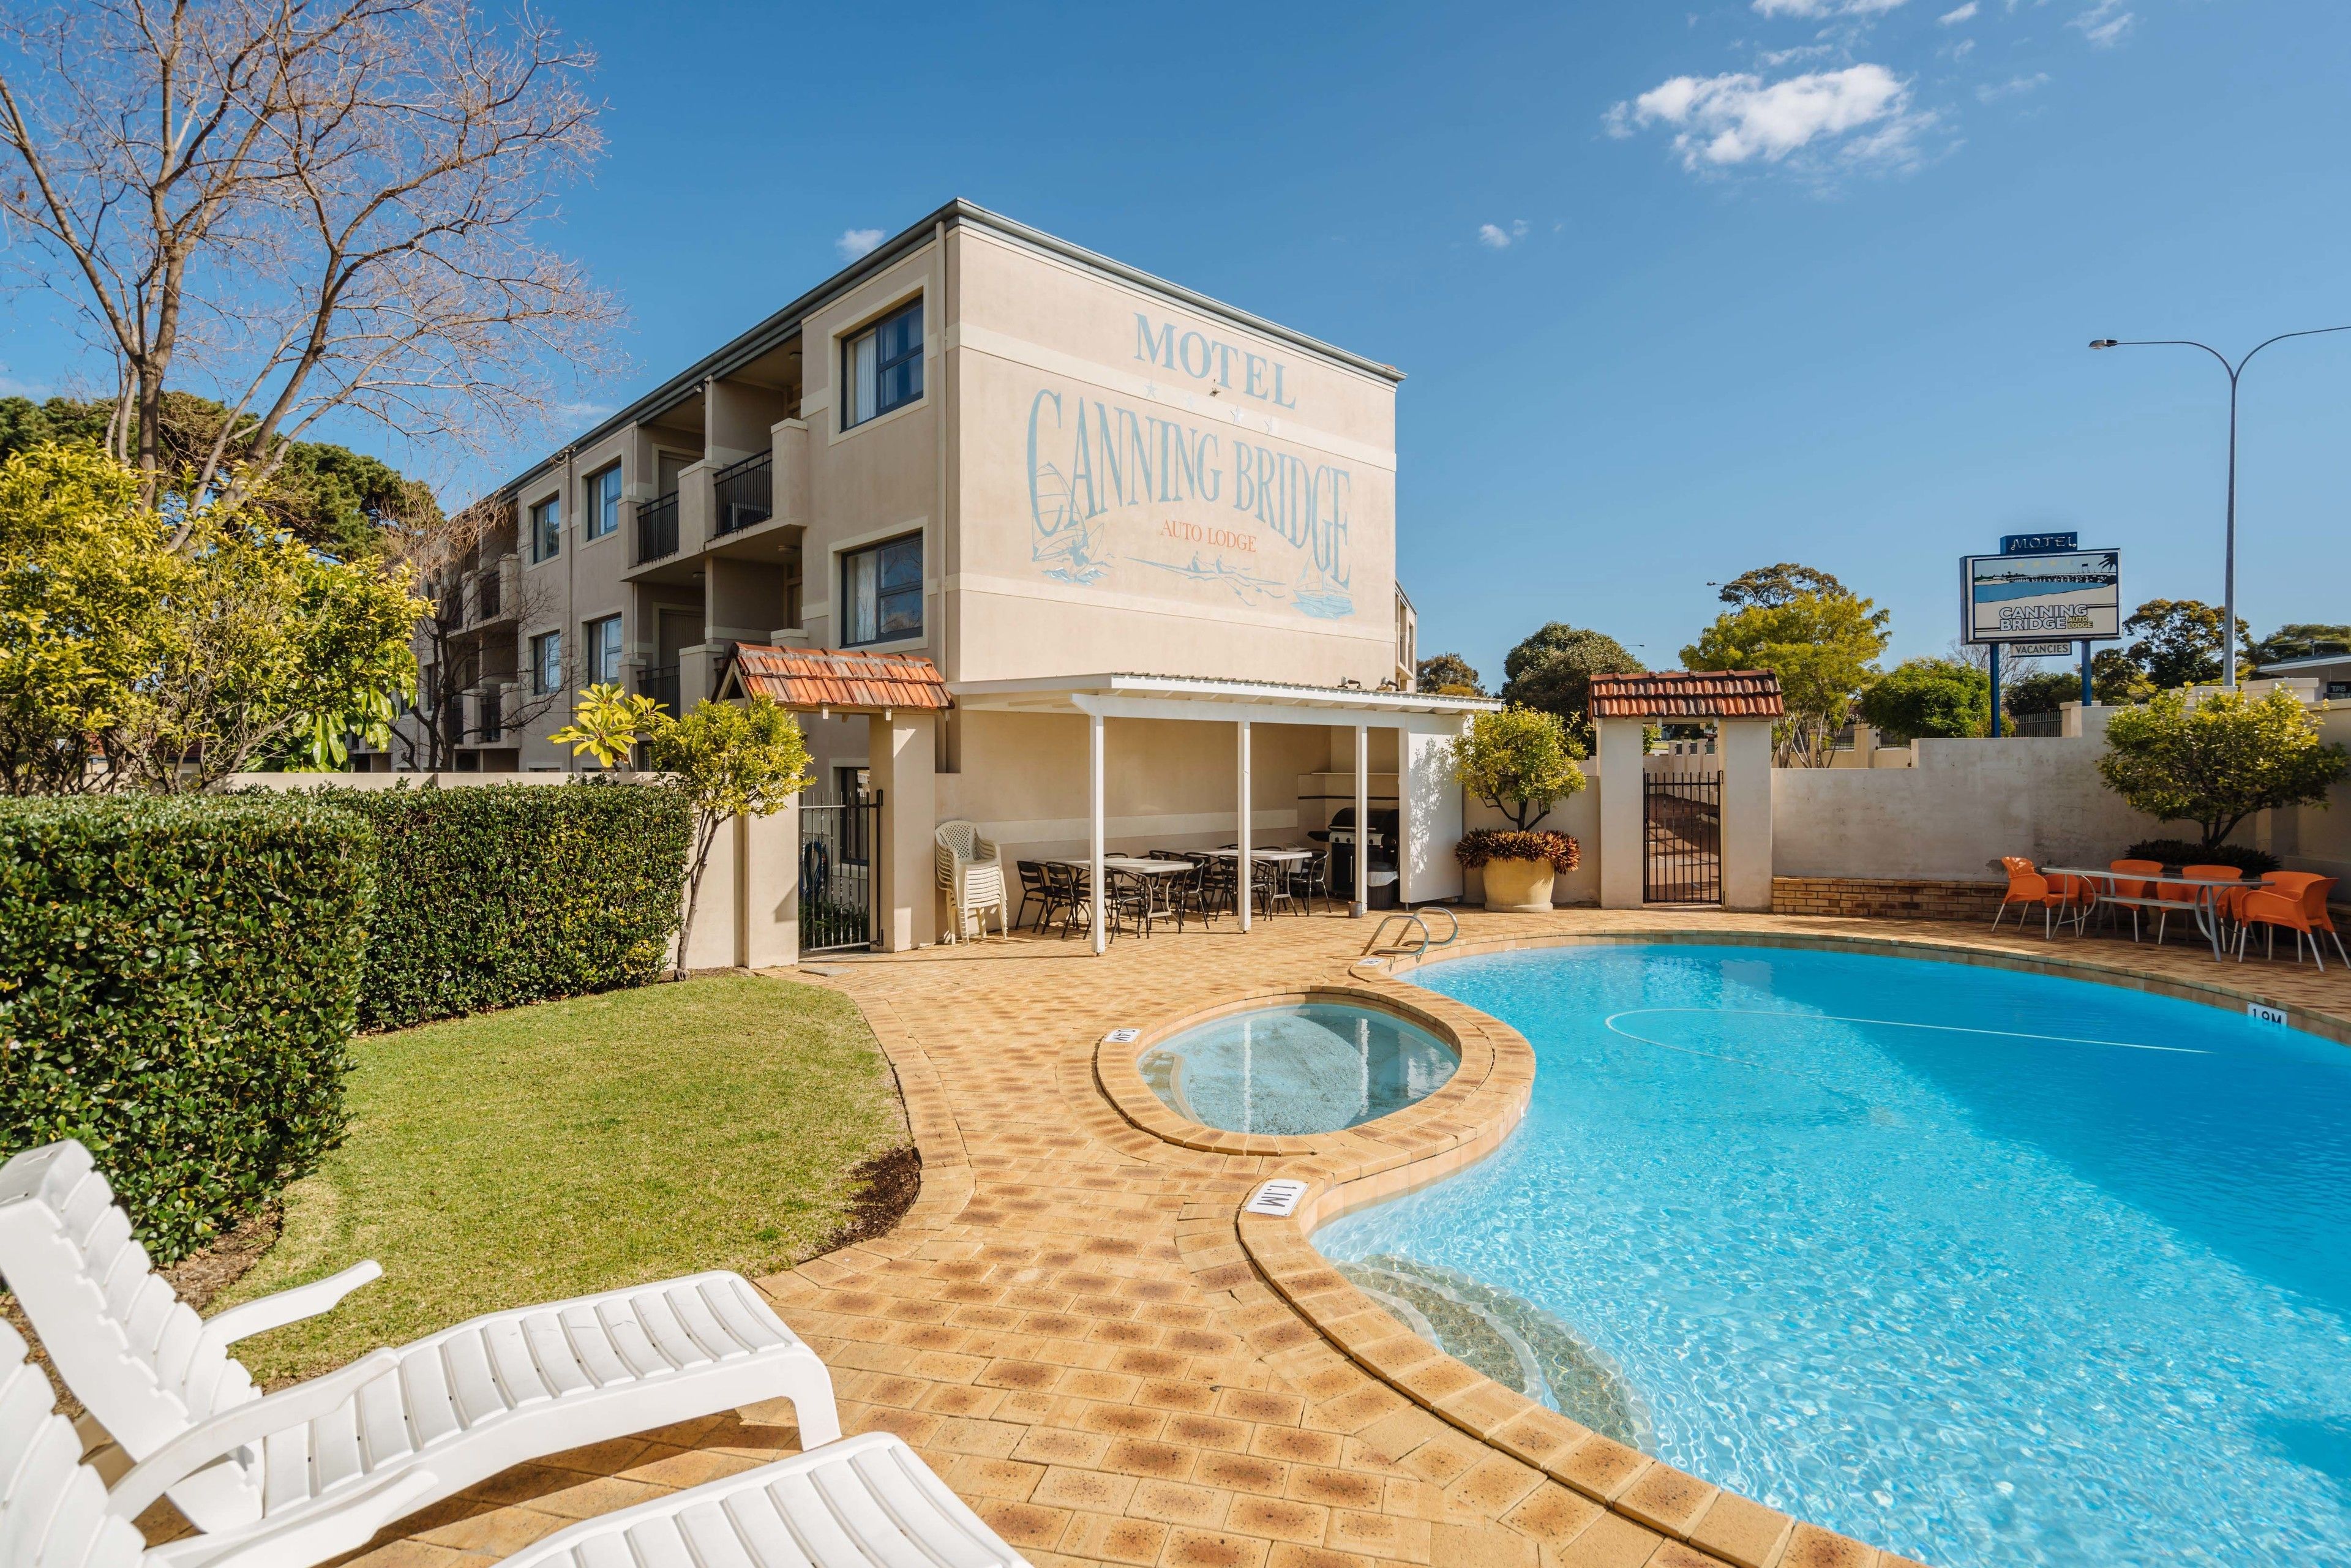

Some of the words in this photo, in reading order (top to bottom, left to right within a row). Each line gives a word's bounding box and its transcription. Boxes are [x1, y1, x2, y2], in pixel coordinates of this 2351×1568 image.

[1134, 313, 1296, 410] MOTEL
[1027, 389, 1223, 538] CANNING
[1233, 440, 1350, 585] BRIDGE
[1160, 519, 1202, 542] AUTO
[1207, 528, 1257, 552] LODGE
[2011, 536, 2077, 550] MOTEL
[1999, 604, 2088, 620] CANNING
[2000, 617, 2066, 631] BRIDGE
[2015, 644, 2068, 655] VACANCIES
[1256, 1185, 1297, 1207] 1.1M
